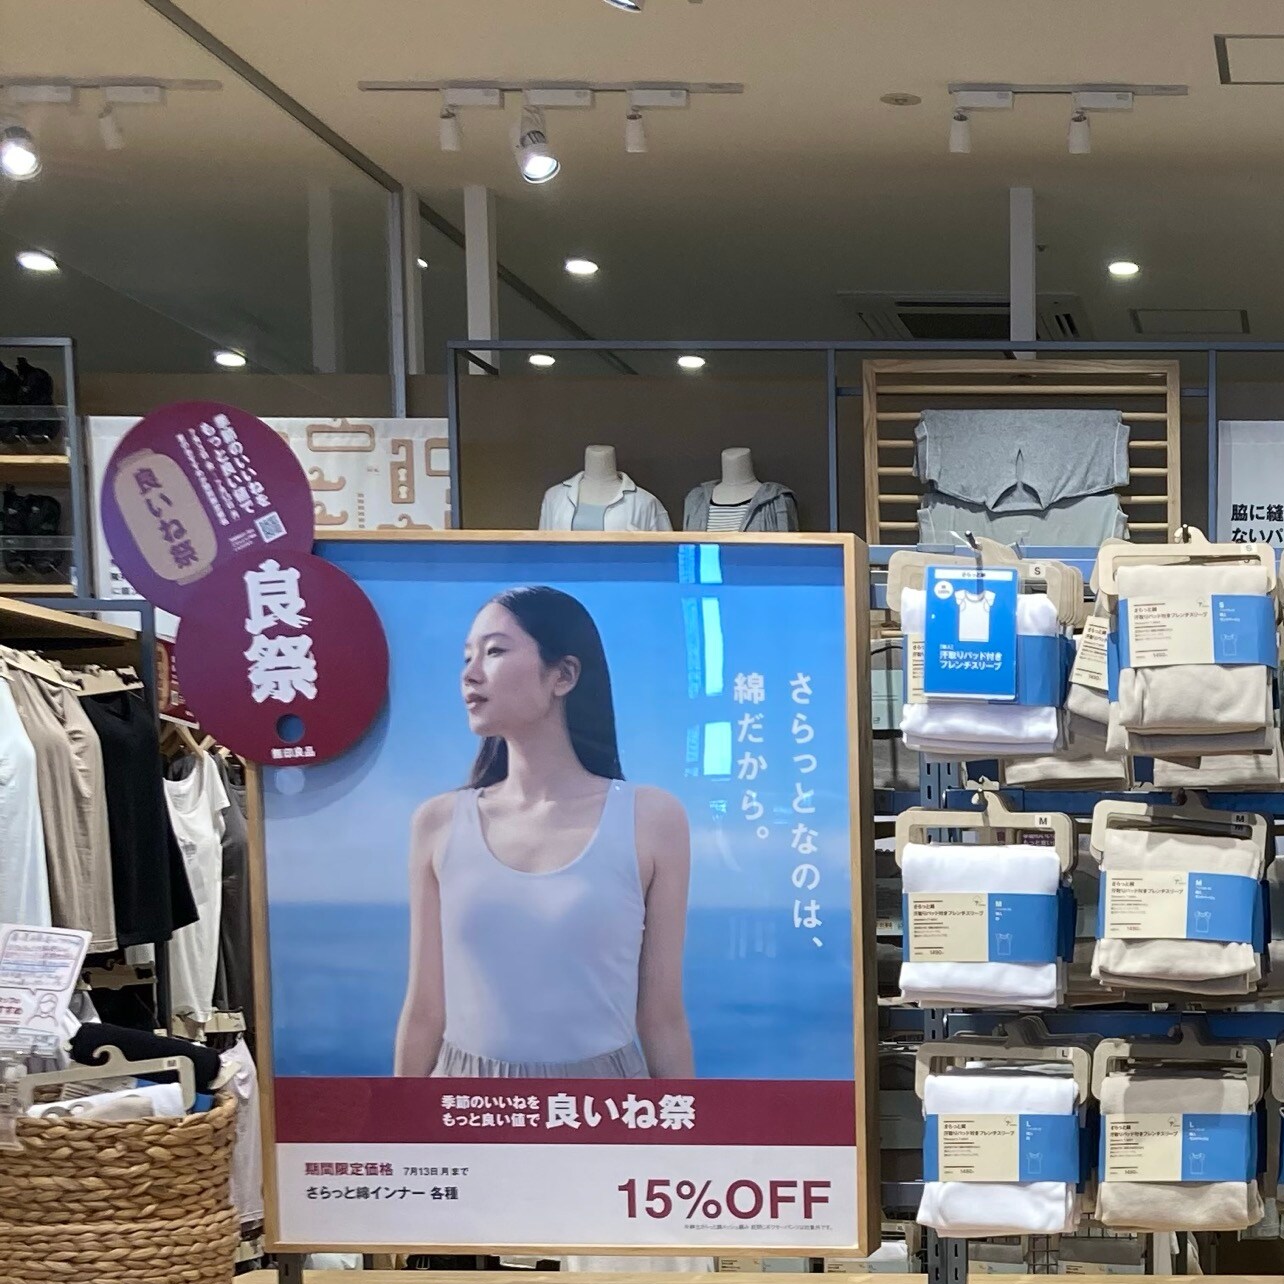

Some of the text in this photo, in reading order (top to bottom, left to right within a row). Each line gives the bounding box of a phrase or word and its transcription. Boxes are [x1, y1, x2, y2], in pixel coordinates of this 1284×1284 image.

[133, 467, 198, 570] 良いね祭
[1034, 567, 1041, 575] S
[243, 558, 318, 704] 良祭
[940, 651, 1002, 661] 汗取りパッド付き
[940, 661, 1002, 670] フレンチスリーブ
[734, 672, 769, 840] 綿だから。
[789, 672, 823, 948] さらっとなのは、
[1039, 817, 1048, 825] M
[441, 1095, 540, 1110] 季節のいいねを
[442, 1112, 540, 1127] もっと良い値で
[545, 1094, 695, 1131] 良いね祭
[305, 1163, 393, 1176] 期間限定価格
[307, 1187, 458, 1200] さらっと綿インナー 各種
[617, 1179, 831, 1220] 15%OFF
